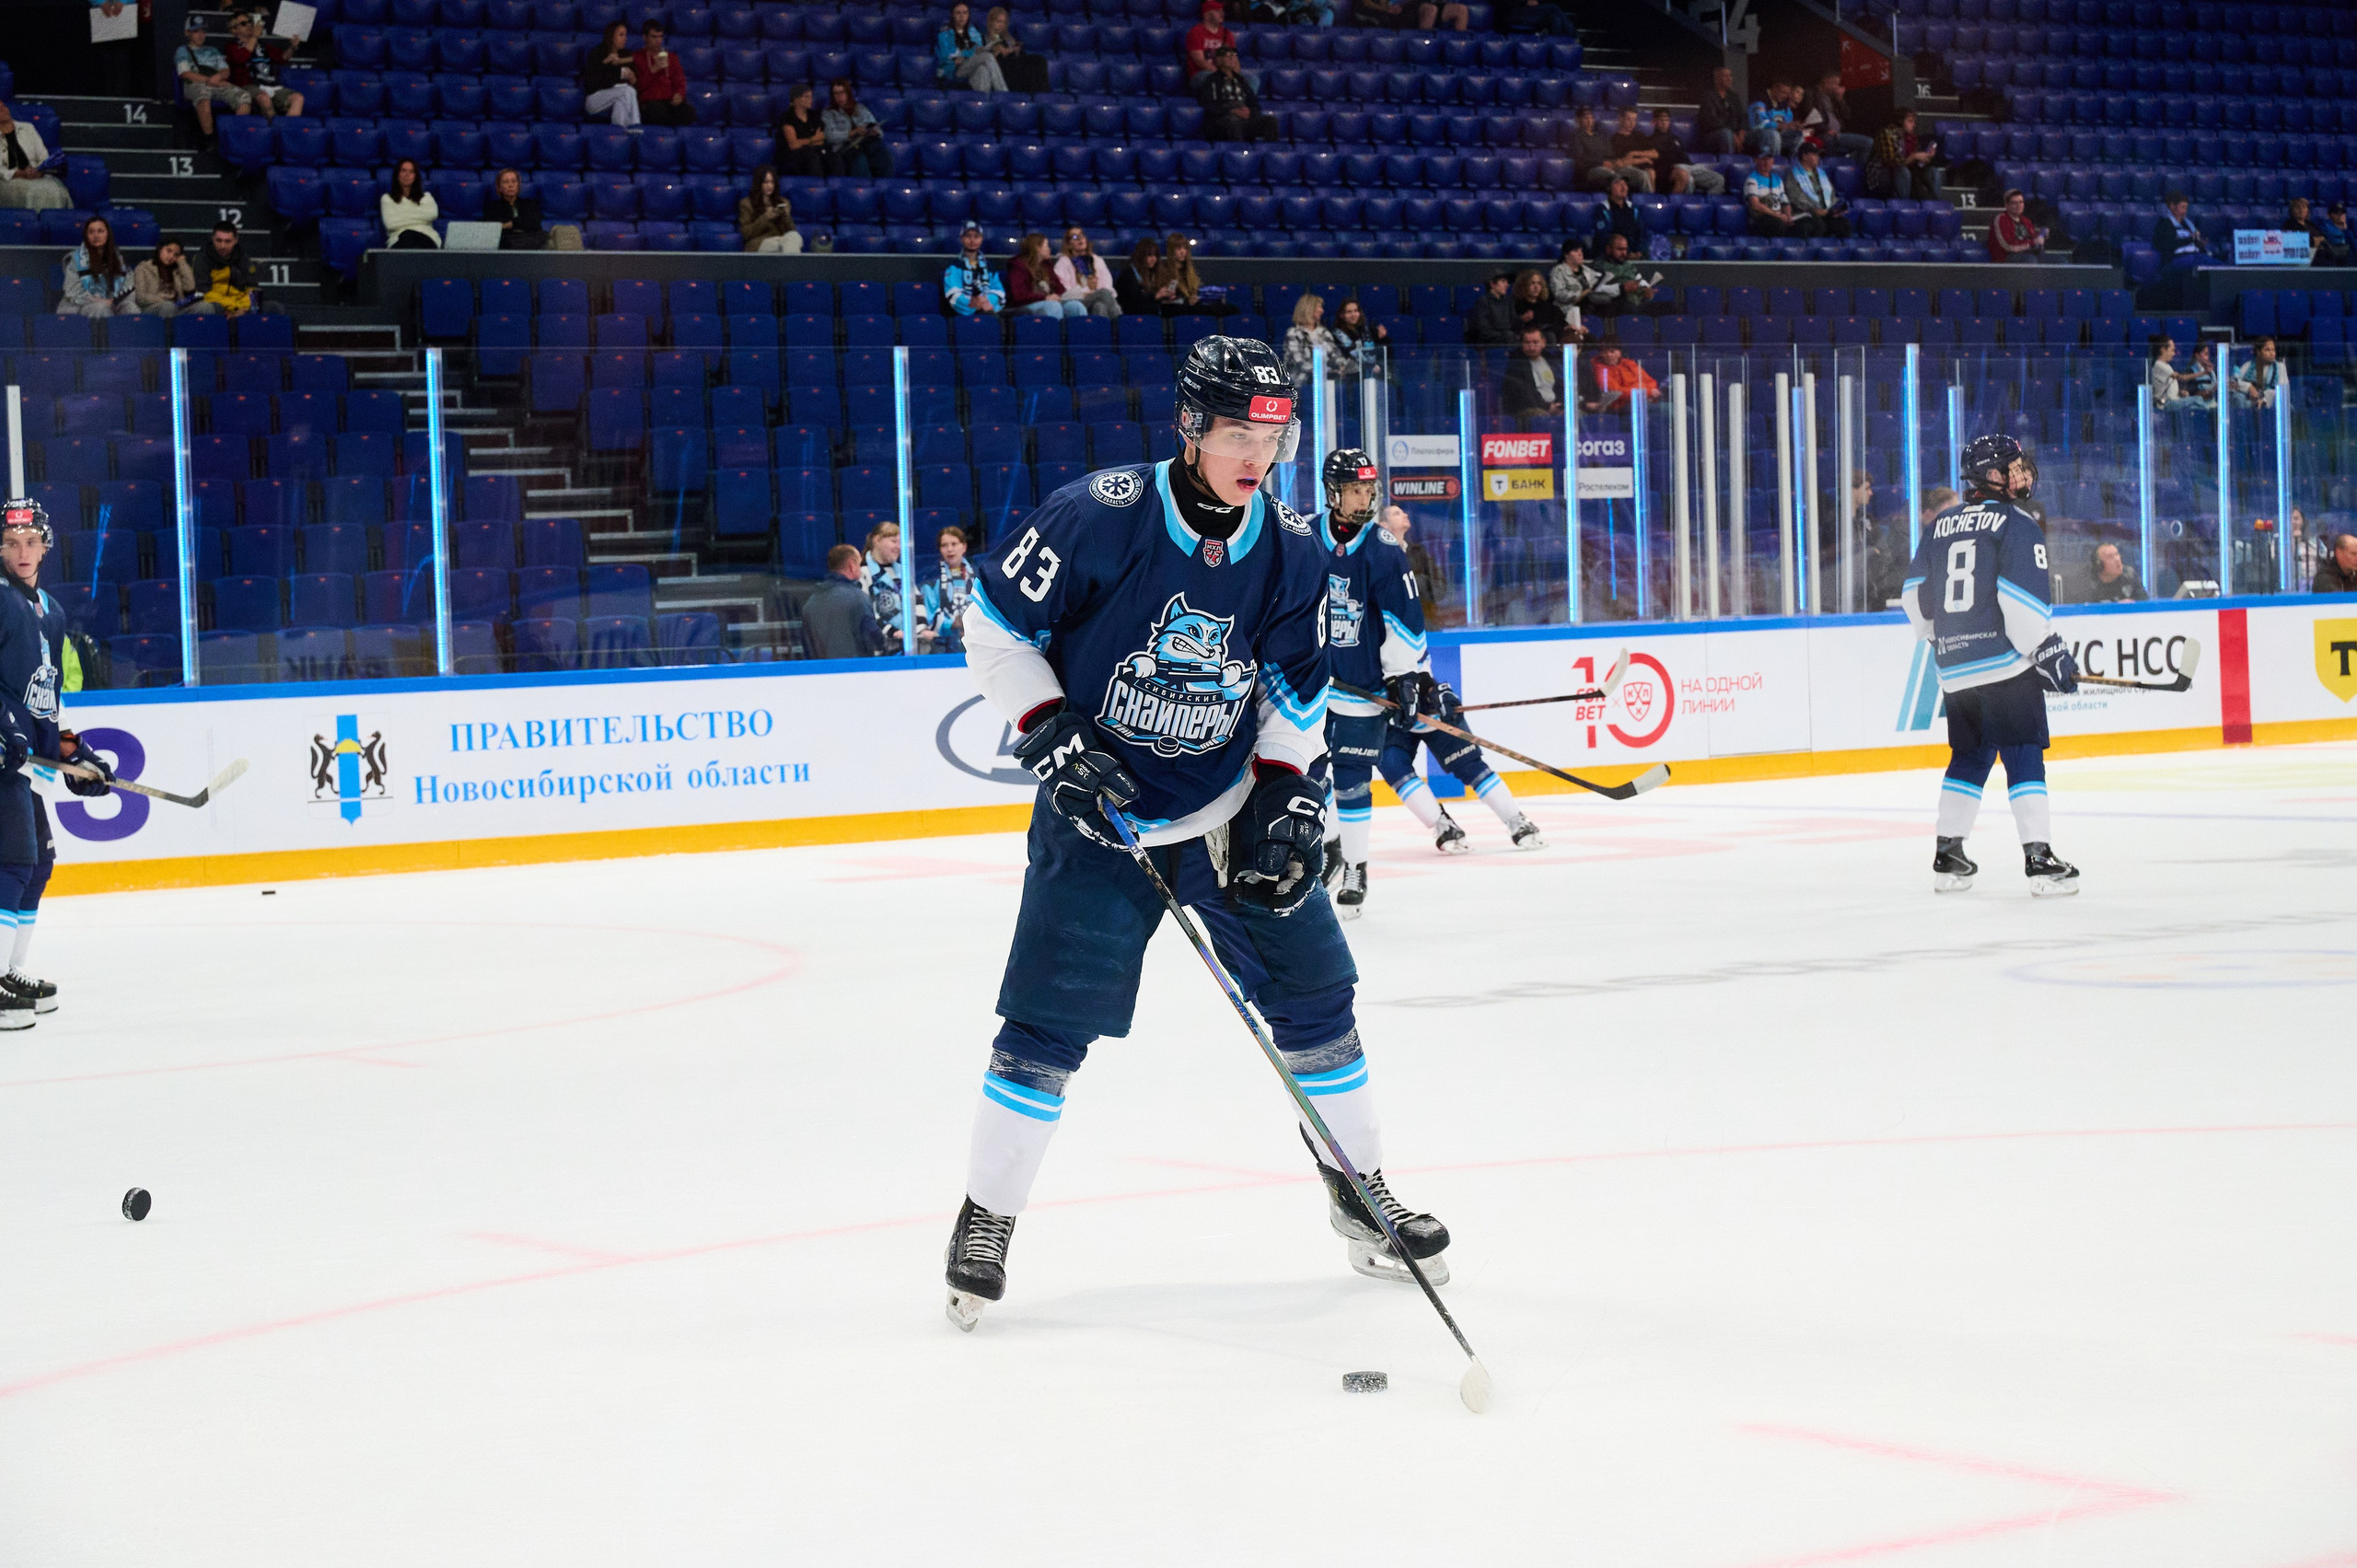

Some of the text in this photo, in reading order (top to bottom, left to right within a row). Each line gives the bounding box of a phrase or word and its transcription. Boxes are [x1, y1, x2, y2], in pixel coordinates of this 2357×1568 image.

[123, 103, 147, 123] 14
[169, 156, 194, 177] 13
[1960, 193, 1976, 208] 13
[219, 208, 243, 228] 12
[269, 264, 290, 285] 11
[1253, 365, 1281, 385] 83
[1250, 412, 1287, 421] OLIMPBET
[1483, 439, 1550, 459] FONBET
[1393, 481, 1446, 495] WINLINE
[1511, 479, 1546, 490] БАНК
[1933, 511, 2007, 540] KOCHETOV
[1001, 526, 1062, 603] 83
[2033, 542, 2048, 570] 8
[1944, 539, 1976, 614] 8
[1681, 671, 1763, 693] НА ОДНОЙ
[1144, 682, 1217, 703] СИБИРСКИЕ
[1574, 705, 1607, 722] BET
[1681, 698, 1736, 715] ЛИНИИ
[2071, 701, 2108, 711] области
[449, 709, 774, 752] ПРАВИТЕЛЬСТВО
[1339, 745, 1380, 758] BAUER
[413, 760, 811, 805] Новосибирской области
